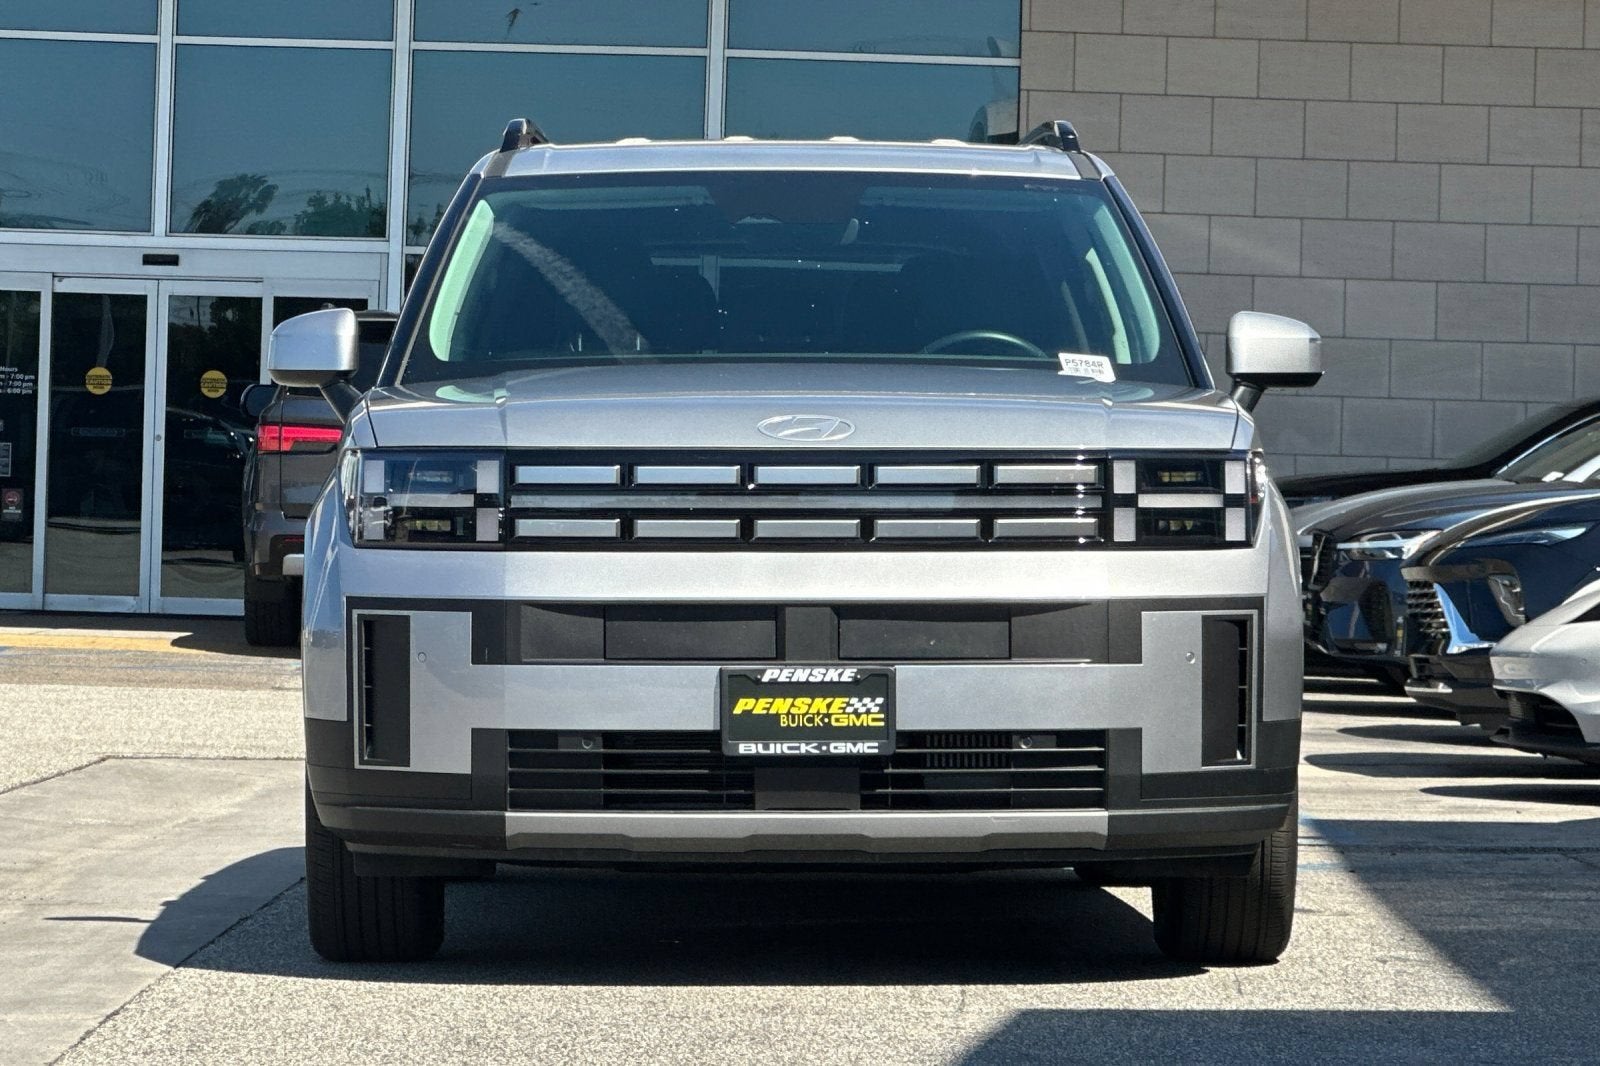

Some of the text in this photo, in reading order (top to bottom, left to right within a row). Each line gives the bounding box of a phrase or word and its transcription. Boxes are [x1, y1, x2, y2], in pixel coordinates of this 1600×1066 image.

[761, 668, 858, 682] PENSKE
[733, 697, 851, 714] PENSKE
[780, 714, 885, 728] BUICK GMC
[738, 742, 879, 754] BUICK GMC
